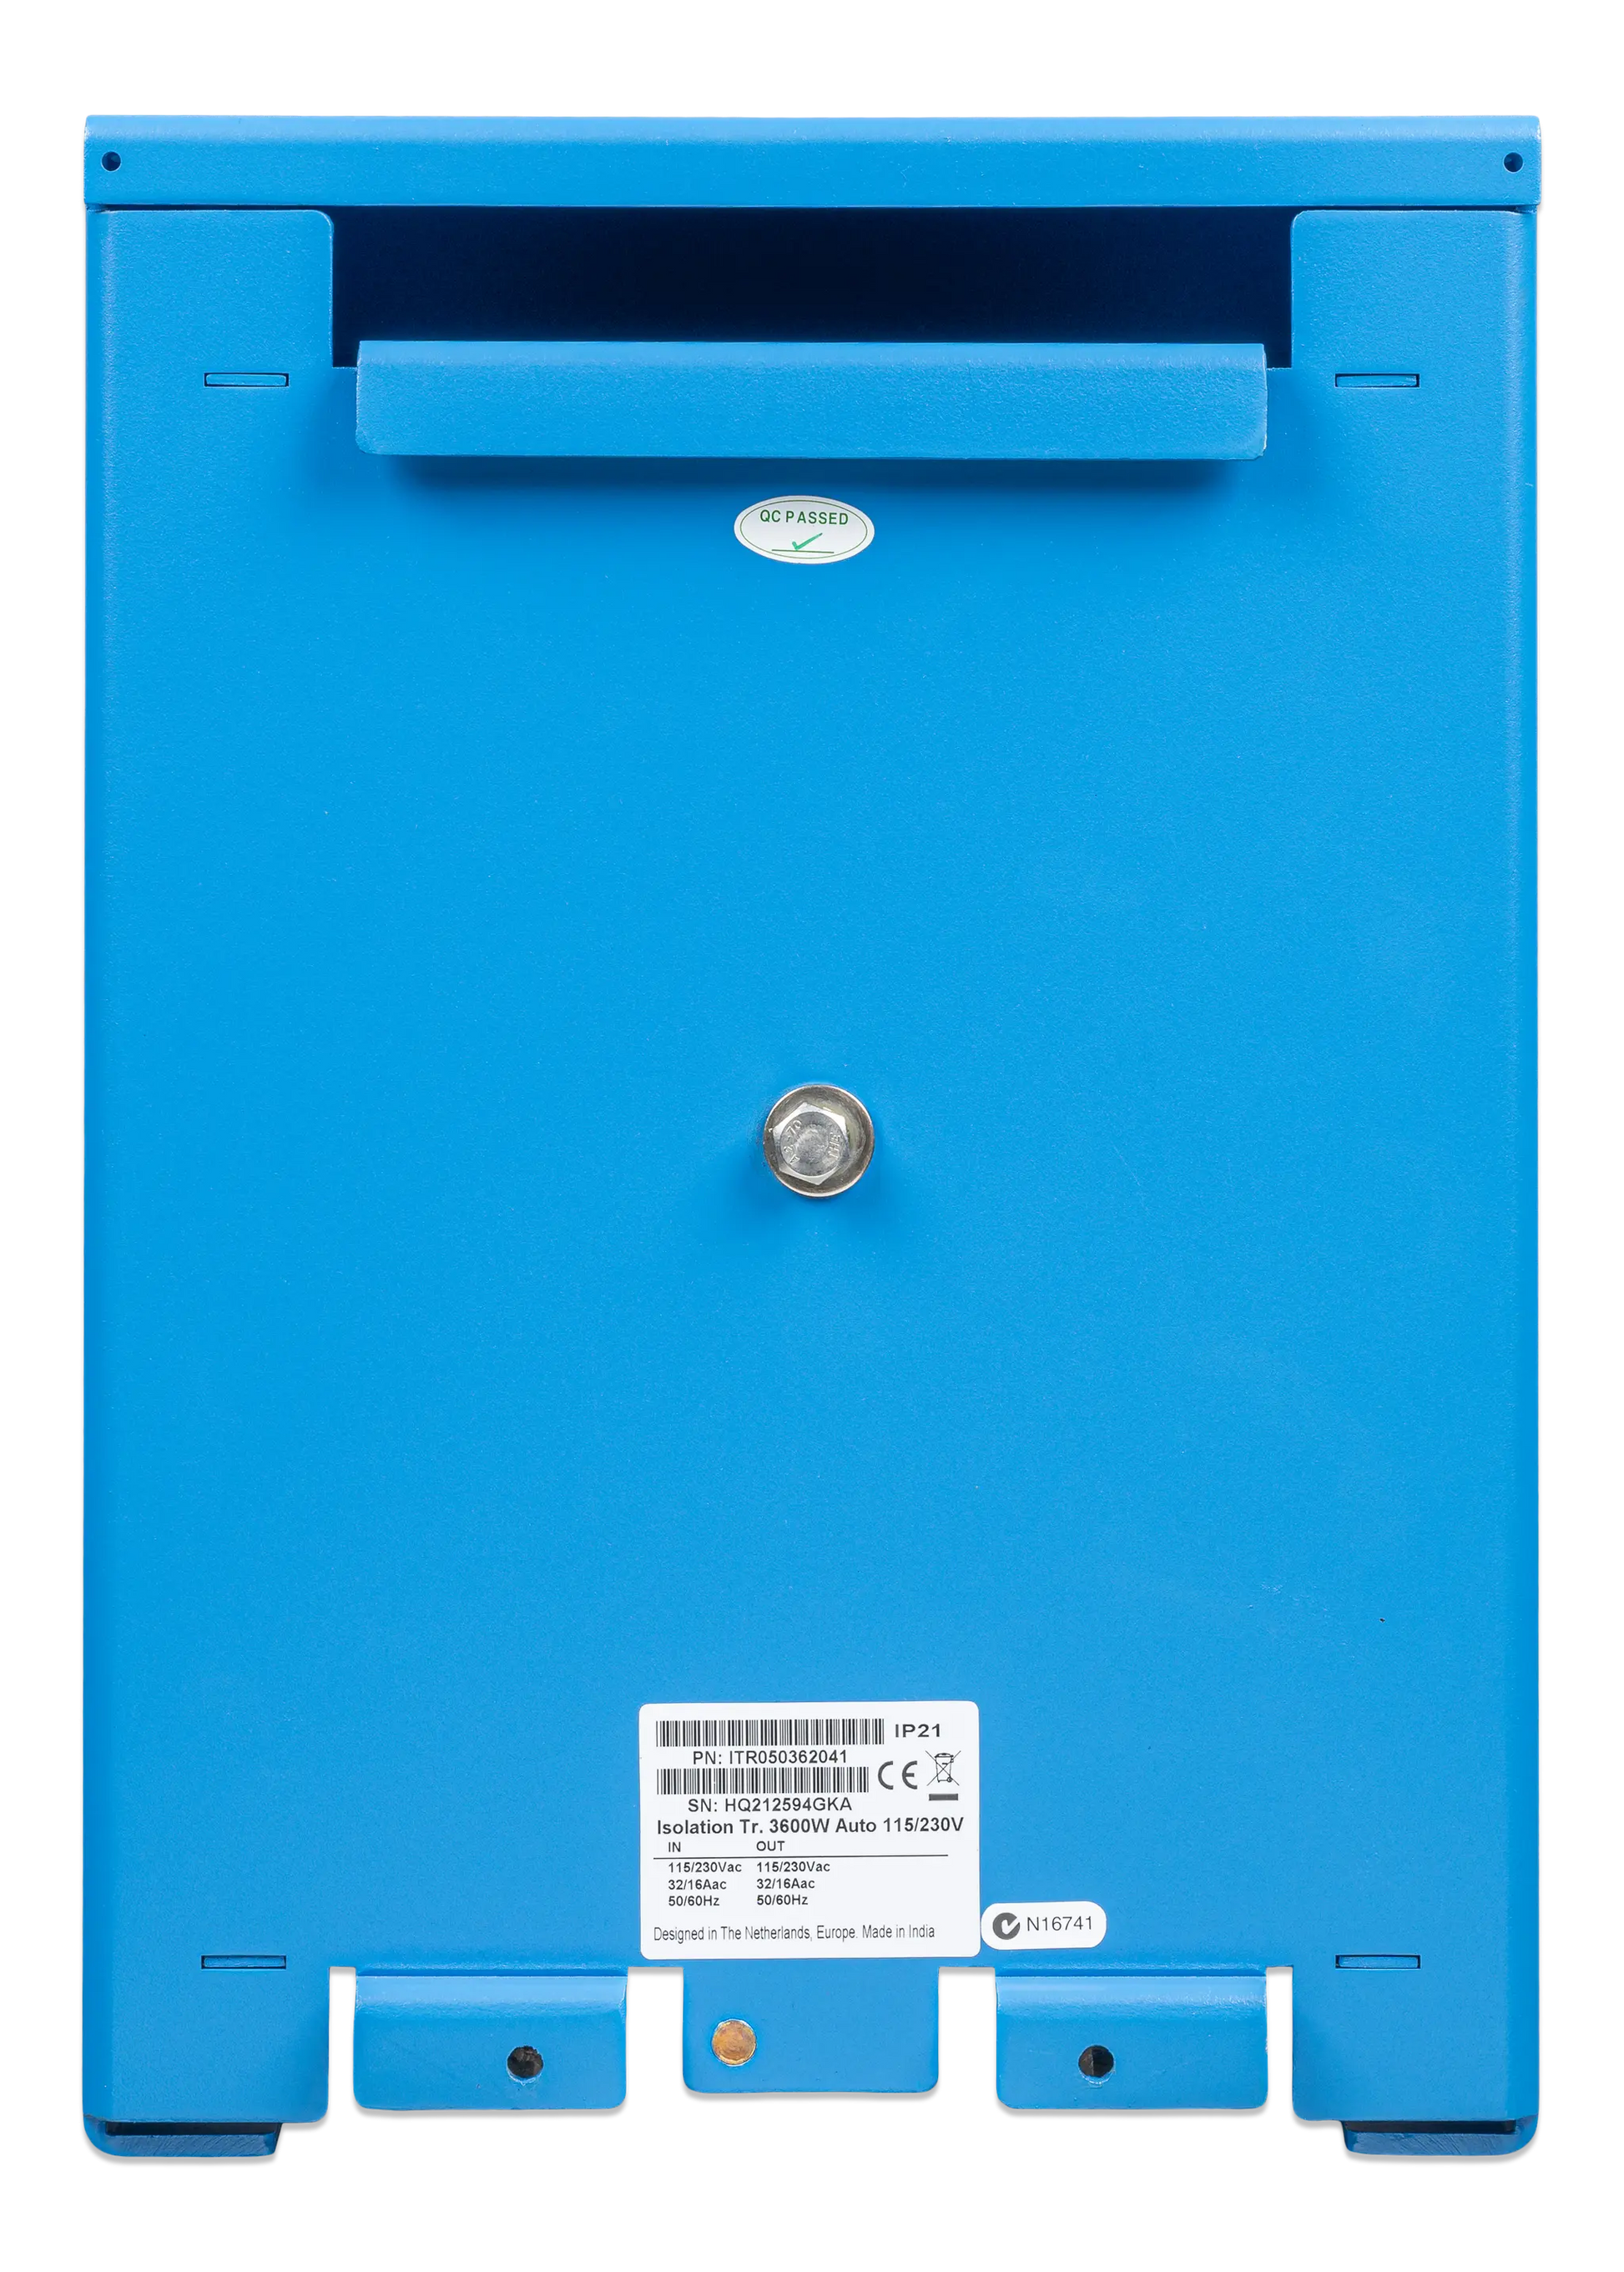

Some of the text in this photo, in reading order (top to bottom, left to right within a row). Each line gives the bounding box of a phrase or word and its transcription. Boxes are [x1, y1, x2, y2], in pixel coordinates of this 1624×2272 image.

[760, 509, 849, 525] QC PASSED
[895, 1724, 941, 1738] IP21
[693, 1749, 846, 1765] PN: ITR050362041
[877, 1760, 918, 1790] CE
[688, 1797, 852, 1813] SN: HQ212594GKA
[658, 1816, 964, 1835] Isolation Tr. 3600W Auto 115/230V
[668, 1841, 681, 1853] IN
[756, 1840, 785, 1852] OUT
[668, 1861, 742, 1873] 115/230Vac
[757, 1861, 830, 1873] 115/230Vac
[668, 1878, 727, 1891] 32/16Aac
[756, 1877, 815, 1890] 32/16Aac
[668, 1895, 720, 1907] 50/60Hz
[756, 1894, 809, 1906] 50/60Hz
[1026, 1916, 1092, 1931] N16741
[653, 1923, 936, 1944] Designed in The Netherlands, Europe. Made in India
